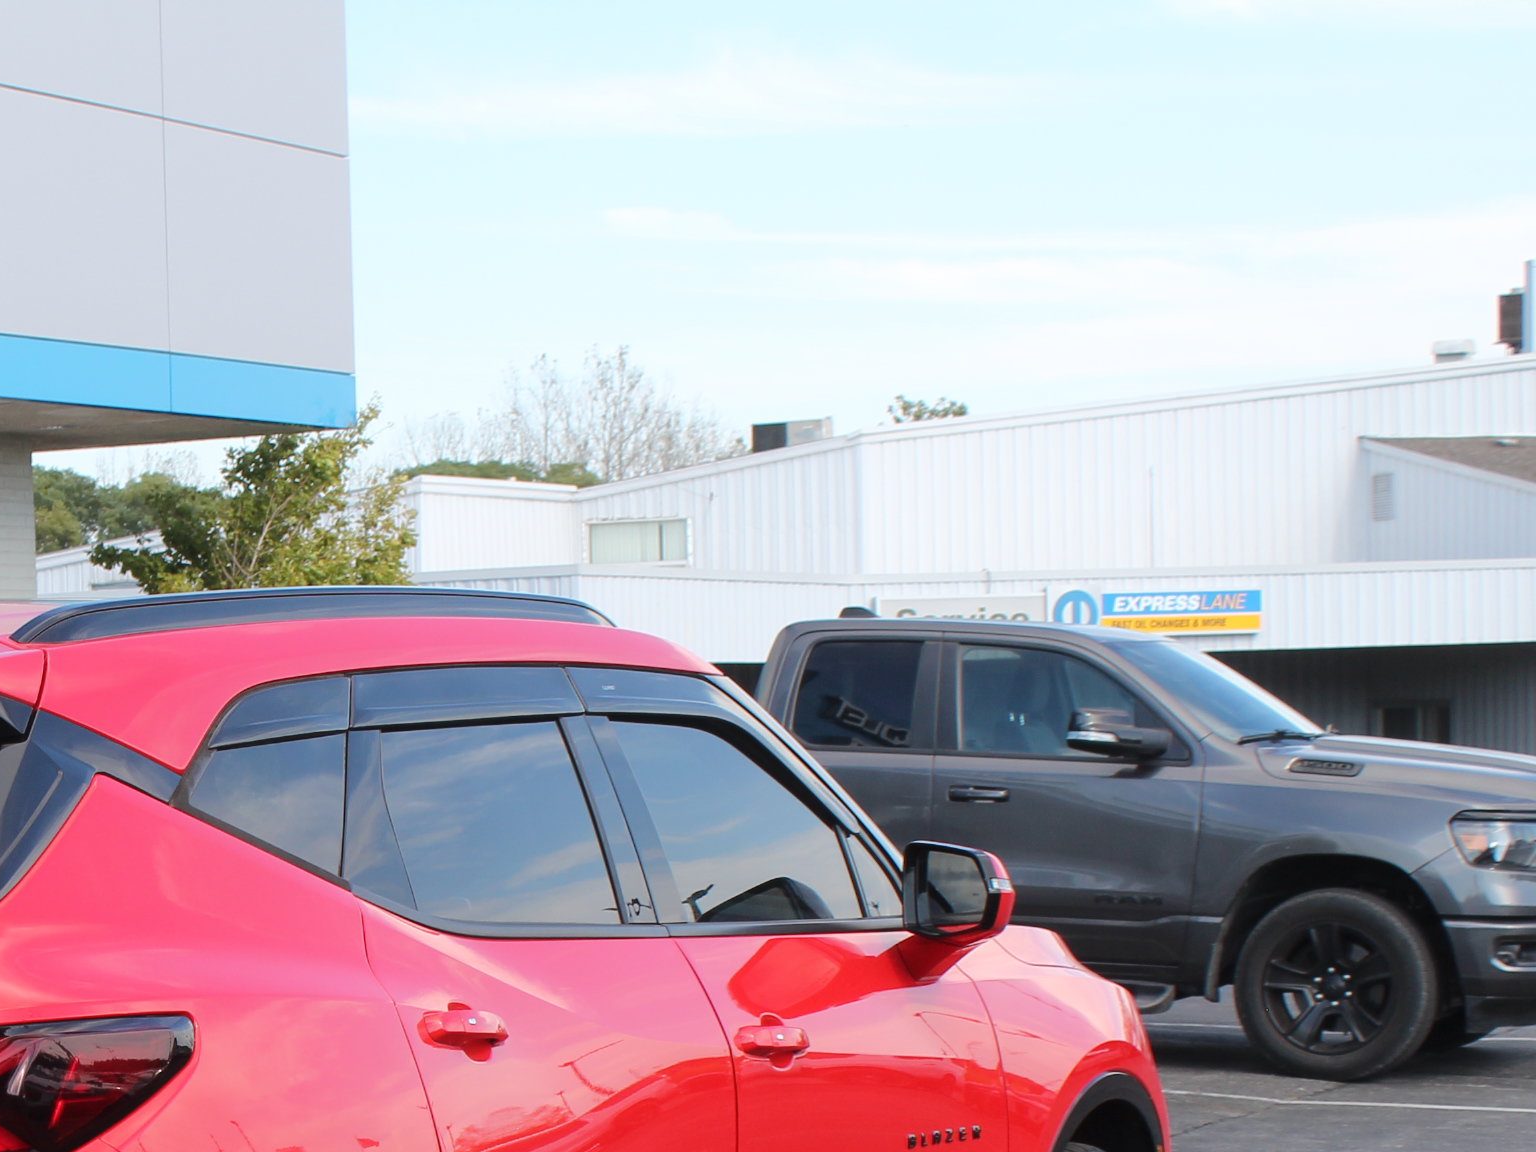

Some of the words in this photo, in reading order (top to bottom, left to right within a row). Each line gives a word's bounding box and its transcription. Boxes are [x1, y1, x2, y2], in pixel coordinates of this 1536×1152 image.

[1111, 619, 1133, 629] FAST
[1135, 619, 1147, 628] OIL
[1150, 618, 1191, 628] CHANGES
[1202, 618, 1227, 628] MORE
[907, 1124, 982, 1150] BLAZER
